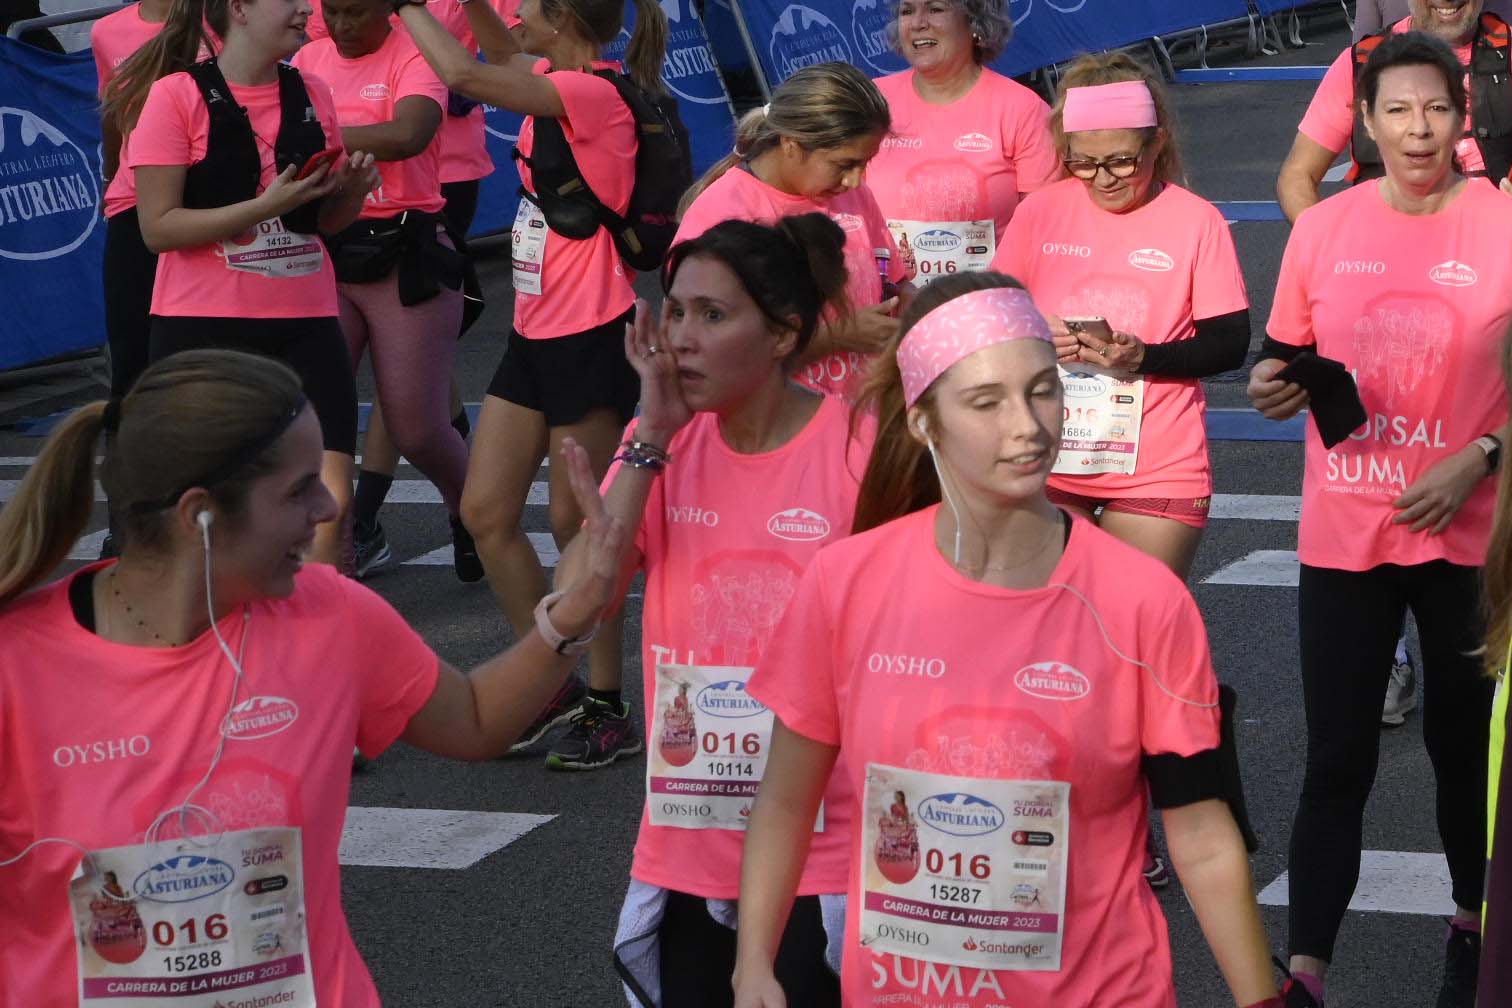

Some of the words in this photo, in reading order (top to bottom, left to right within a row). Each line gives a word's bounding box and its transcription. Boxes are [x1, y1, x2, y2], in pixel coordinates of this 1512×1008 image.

[881, 137, 923, 150] OYSHO
[266, 236, 292, 247] 14132
[917, 236, 958, 248] ASTURIANA
[1042, 242, 1091, 258] OYSHO
[239, 250, 269, 262] CARRERA
[920, 260, 957, 274] 016
[1333, 259, 1386, 275] OYSHO
[1090, 458, 1125, 466] Santander
[1326, 451, 1407, 491] SUMA
[771, 517, 826, 536] ASTURIANA
[867, 652, 947, 679] OYSHO
[1017, 669, 1086, 694] ASTURIANA
[228, 709, 295, 736] ASTURIANA
[52, 734, 152, 769] OYSHO
[702, 731, 761, 755] 016
[708, 762, 753, 777] 10114
[665, 781, 708, 792] CARRERA
[711, 783, 725, 792] DE
[726, 784, 741, 793] LA
[662, 802, 712, 817] OYSHO
[924, 804, 998, 829] ASTURIANA
[1012, 806, 1054, 818] SUMA
[242, 850, 285, 869] SUMA
[926, 848, 992, 880] 016
[143, 870, 228, 895] ASTURIANA
[930, 884, 982, 904] 15287
[882, 899, 930, 919] CARRERA
[932, 910, 949, 921] DE
[950, 911, 966, 922] LA
[967, 914, 1009, 928] MUJER
[1013, 917, 1042, 928] 2023
[151, 913, 229, 947] 016
[877, 923, 930, 947] OYSHO
[978, 940, 1045, 955] Santander
[163, 950, 223, 973] 15288
[106, 980, 168, 994] CARRERA
[169, 980, 188, 993] DE
[190, 977, 209, 991] LA
[211, 971, 255, 989] MUJER
[259, 963, 288, 978] 2023
[871, 951, 1006, 1000] SUMA
[227, 991, 297, 1008] Santander
